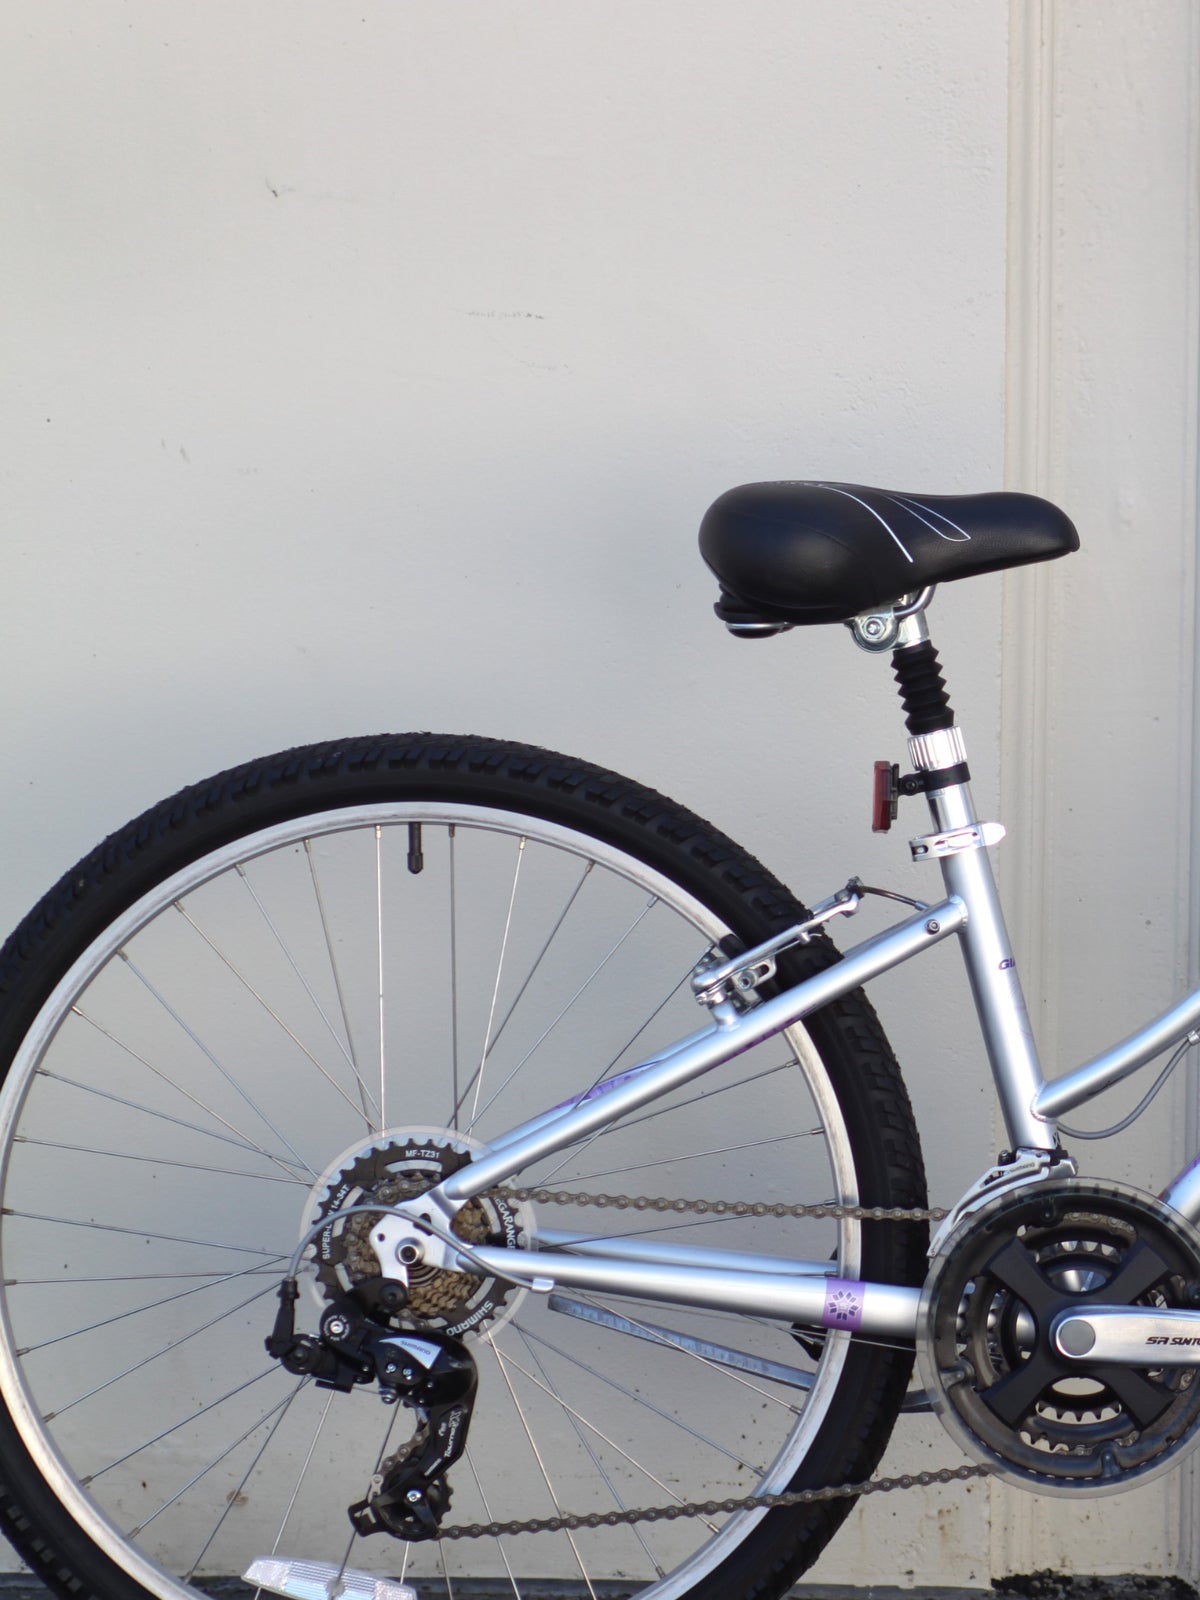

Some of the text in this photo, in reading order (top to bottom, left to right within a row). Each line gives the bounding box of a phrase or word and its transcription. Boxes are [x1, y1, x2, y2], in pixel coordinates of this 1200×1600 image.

[405, 1149, 440, 1159] MF-TZ31
[331, 1184, 350, 1209] 14-34T
[446, 1300, 494, 1336] SHIMANO
[1145, 1336, 1169, 1345] SR
